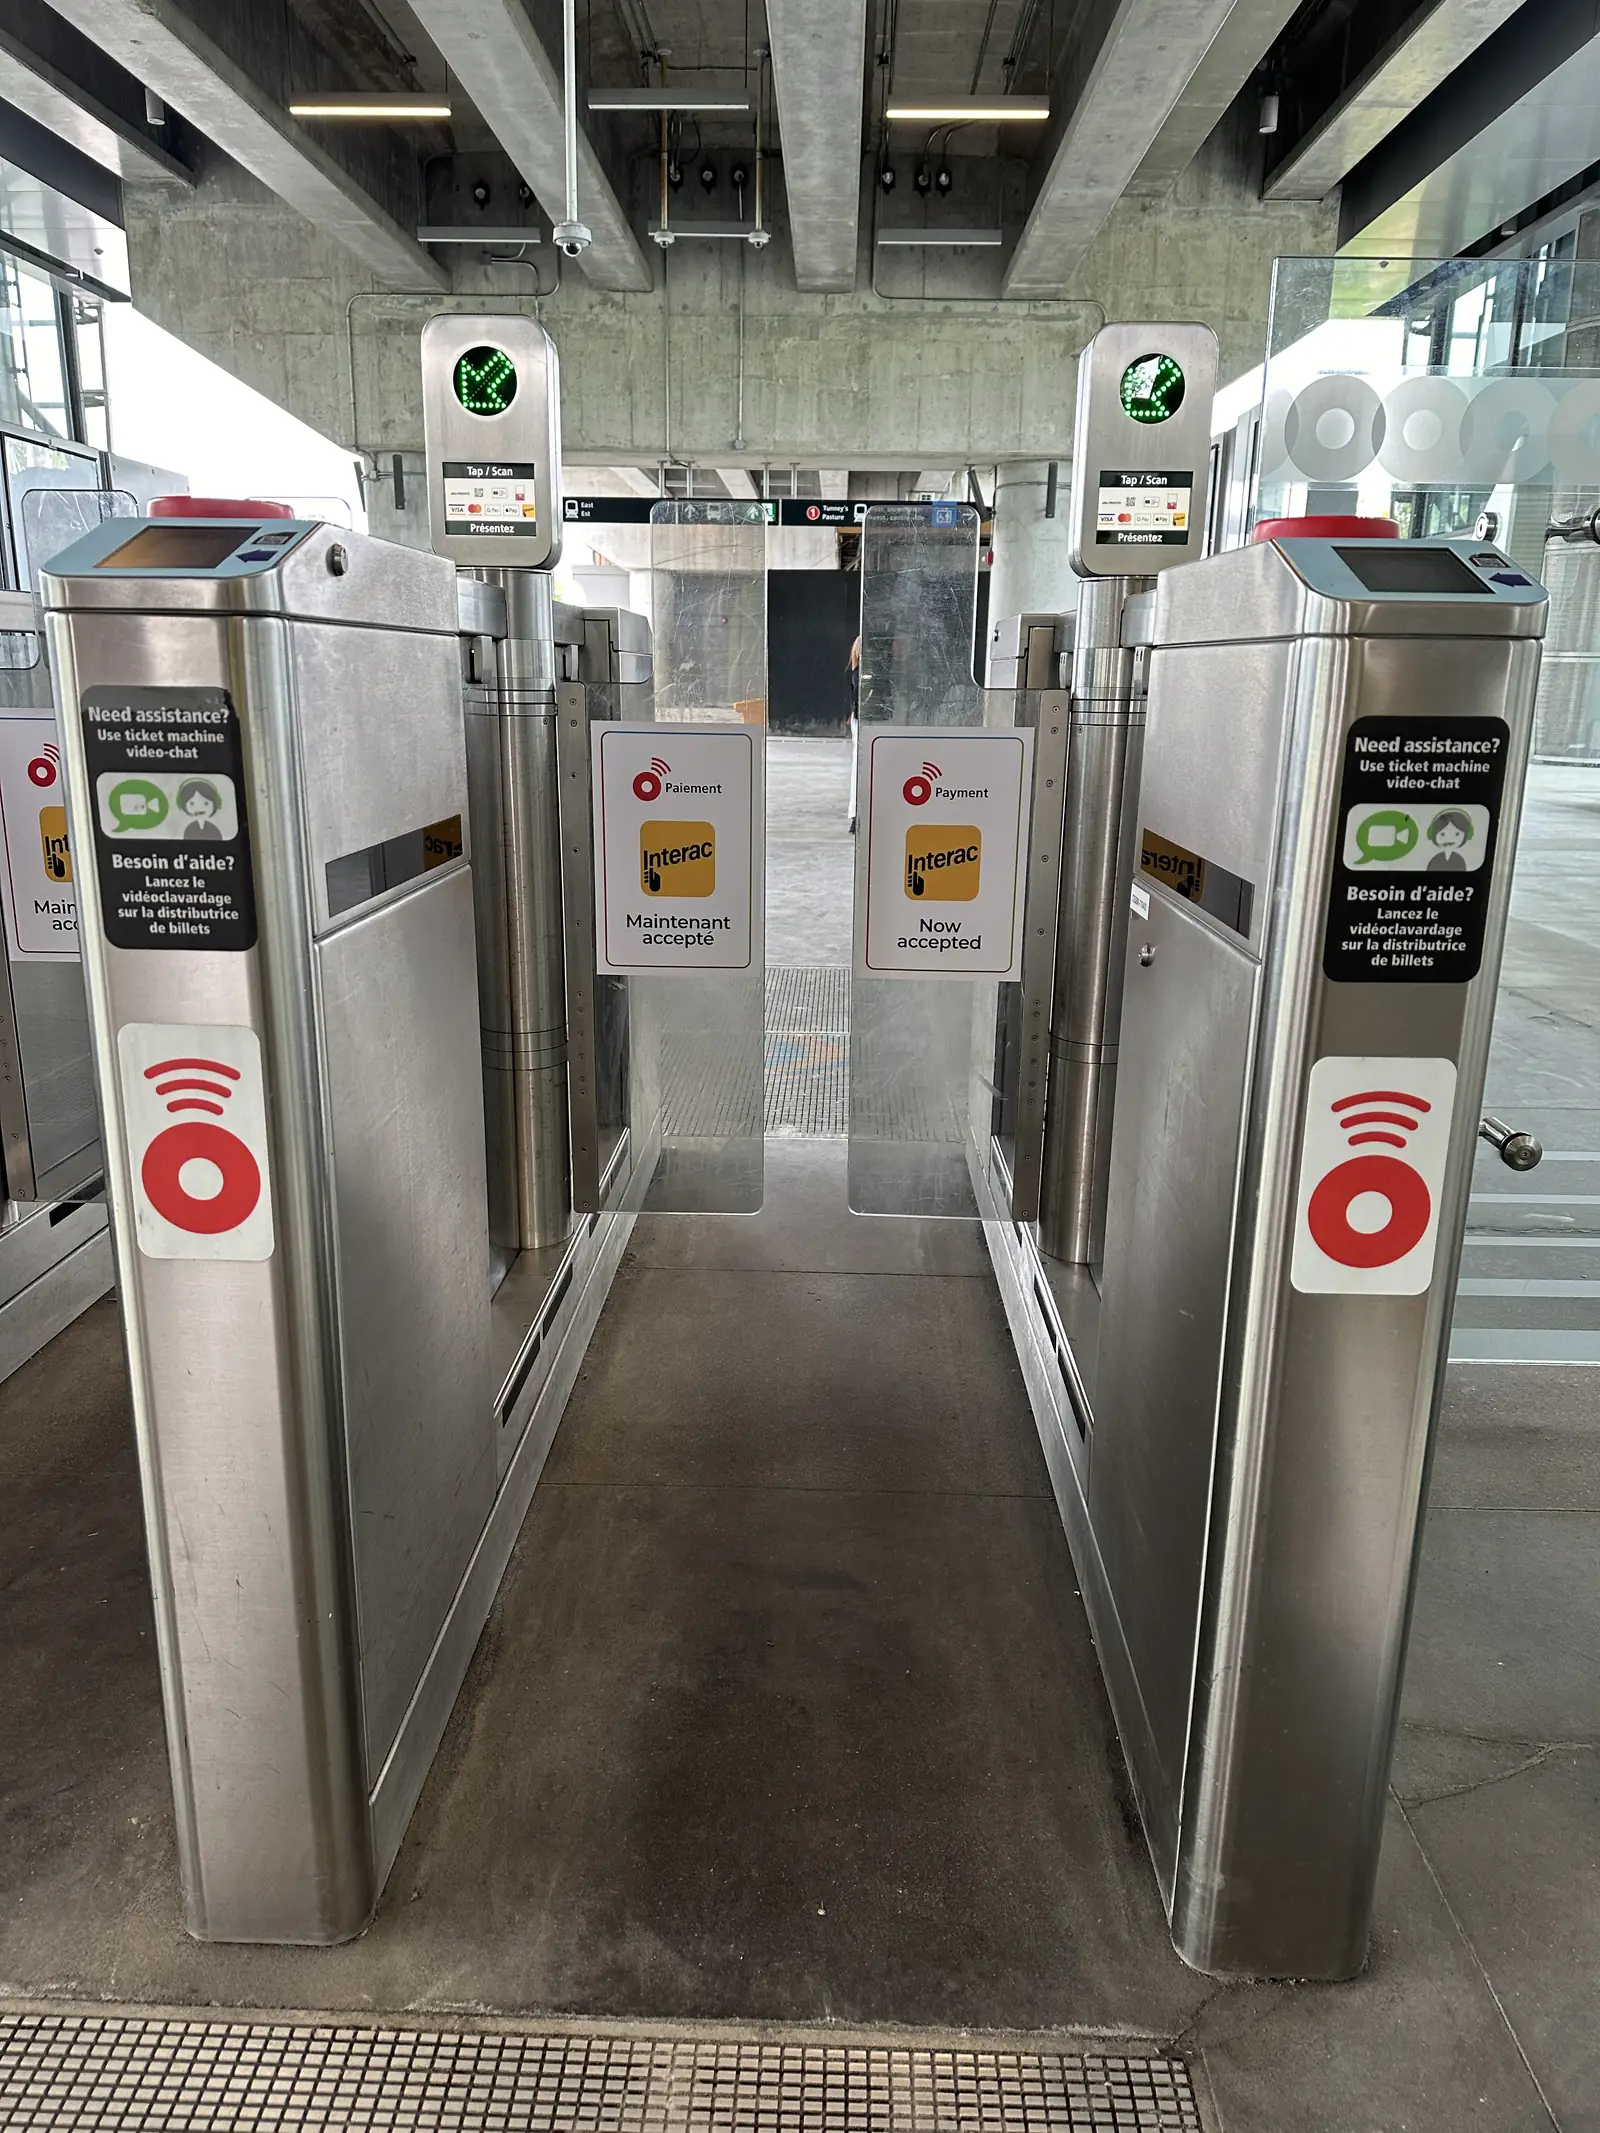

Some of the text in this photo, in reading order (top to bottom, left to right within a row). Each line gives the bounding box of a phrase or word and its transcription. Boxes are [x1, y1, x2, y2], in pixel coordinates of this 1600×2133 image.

[467, 466, 514, 478] Tap / Scan
[1121, 475, 1168, 487] Tap / Scan
[580, 501, 594, 509] East
[822, 504, 849, 513] Tunney's
[470, 523, 515, 533] Présentez
[1117, 533, 1163, 543] Présentez
[87, 706, 230, 724] Need assistance?
[97, 728, 225, 743] Use ticket machine
[126, 745, 199, 759] video-chat
[1354, 736, 1501, 754] Need assistance?
[1360, 759, 1490, 773] Use ticket machine
[665, 782, 723, 794] Paiement
[1386, 775, 1461, 789] video-chat
[935, 787, 989, 801] Payment
[112, 853, 235, 871] Besoin d'aide?
[643, 841, 713, 871] Interac
[907, 845, 979, 875] Interac
[145, 875, 205, 888] Lancez le
[122, 890, 232, 907] vidéoclavardage
[1347, 885, 1474, 902] Besoin d'aide?
[118, 906, 240, 920] sur la distributrice
[1377, 907, 1439, 920] Lancez le
[149, 921, 211, 935] de billets
[626, 913, 731, 930] Maintenant
[919, 918, 962, 933] Now
[1349, 922, 1463, 939] vidéoclavardage
[642, 931, 715, 949] accepté
[897, 935, 982, 952] accepted
[1341, 938, 1467, 951] sur la distributrice
[1371, 953, 1434, 967] de billets
